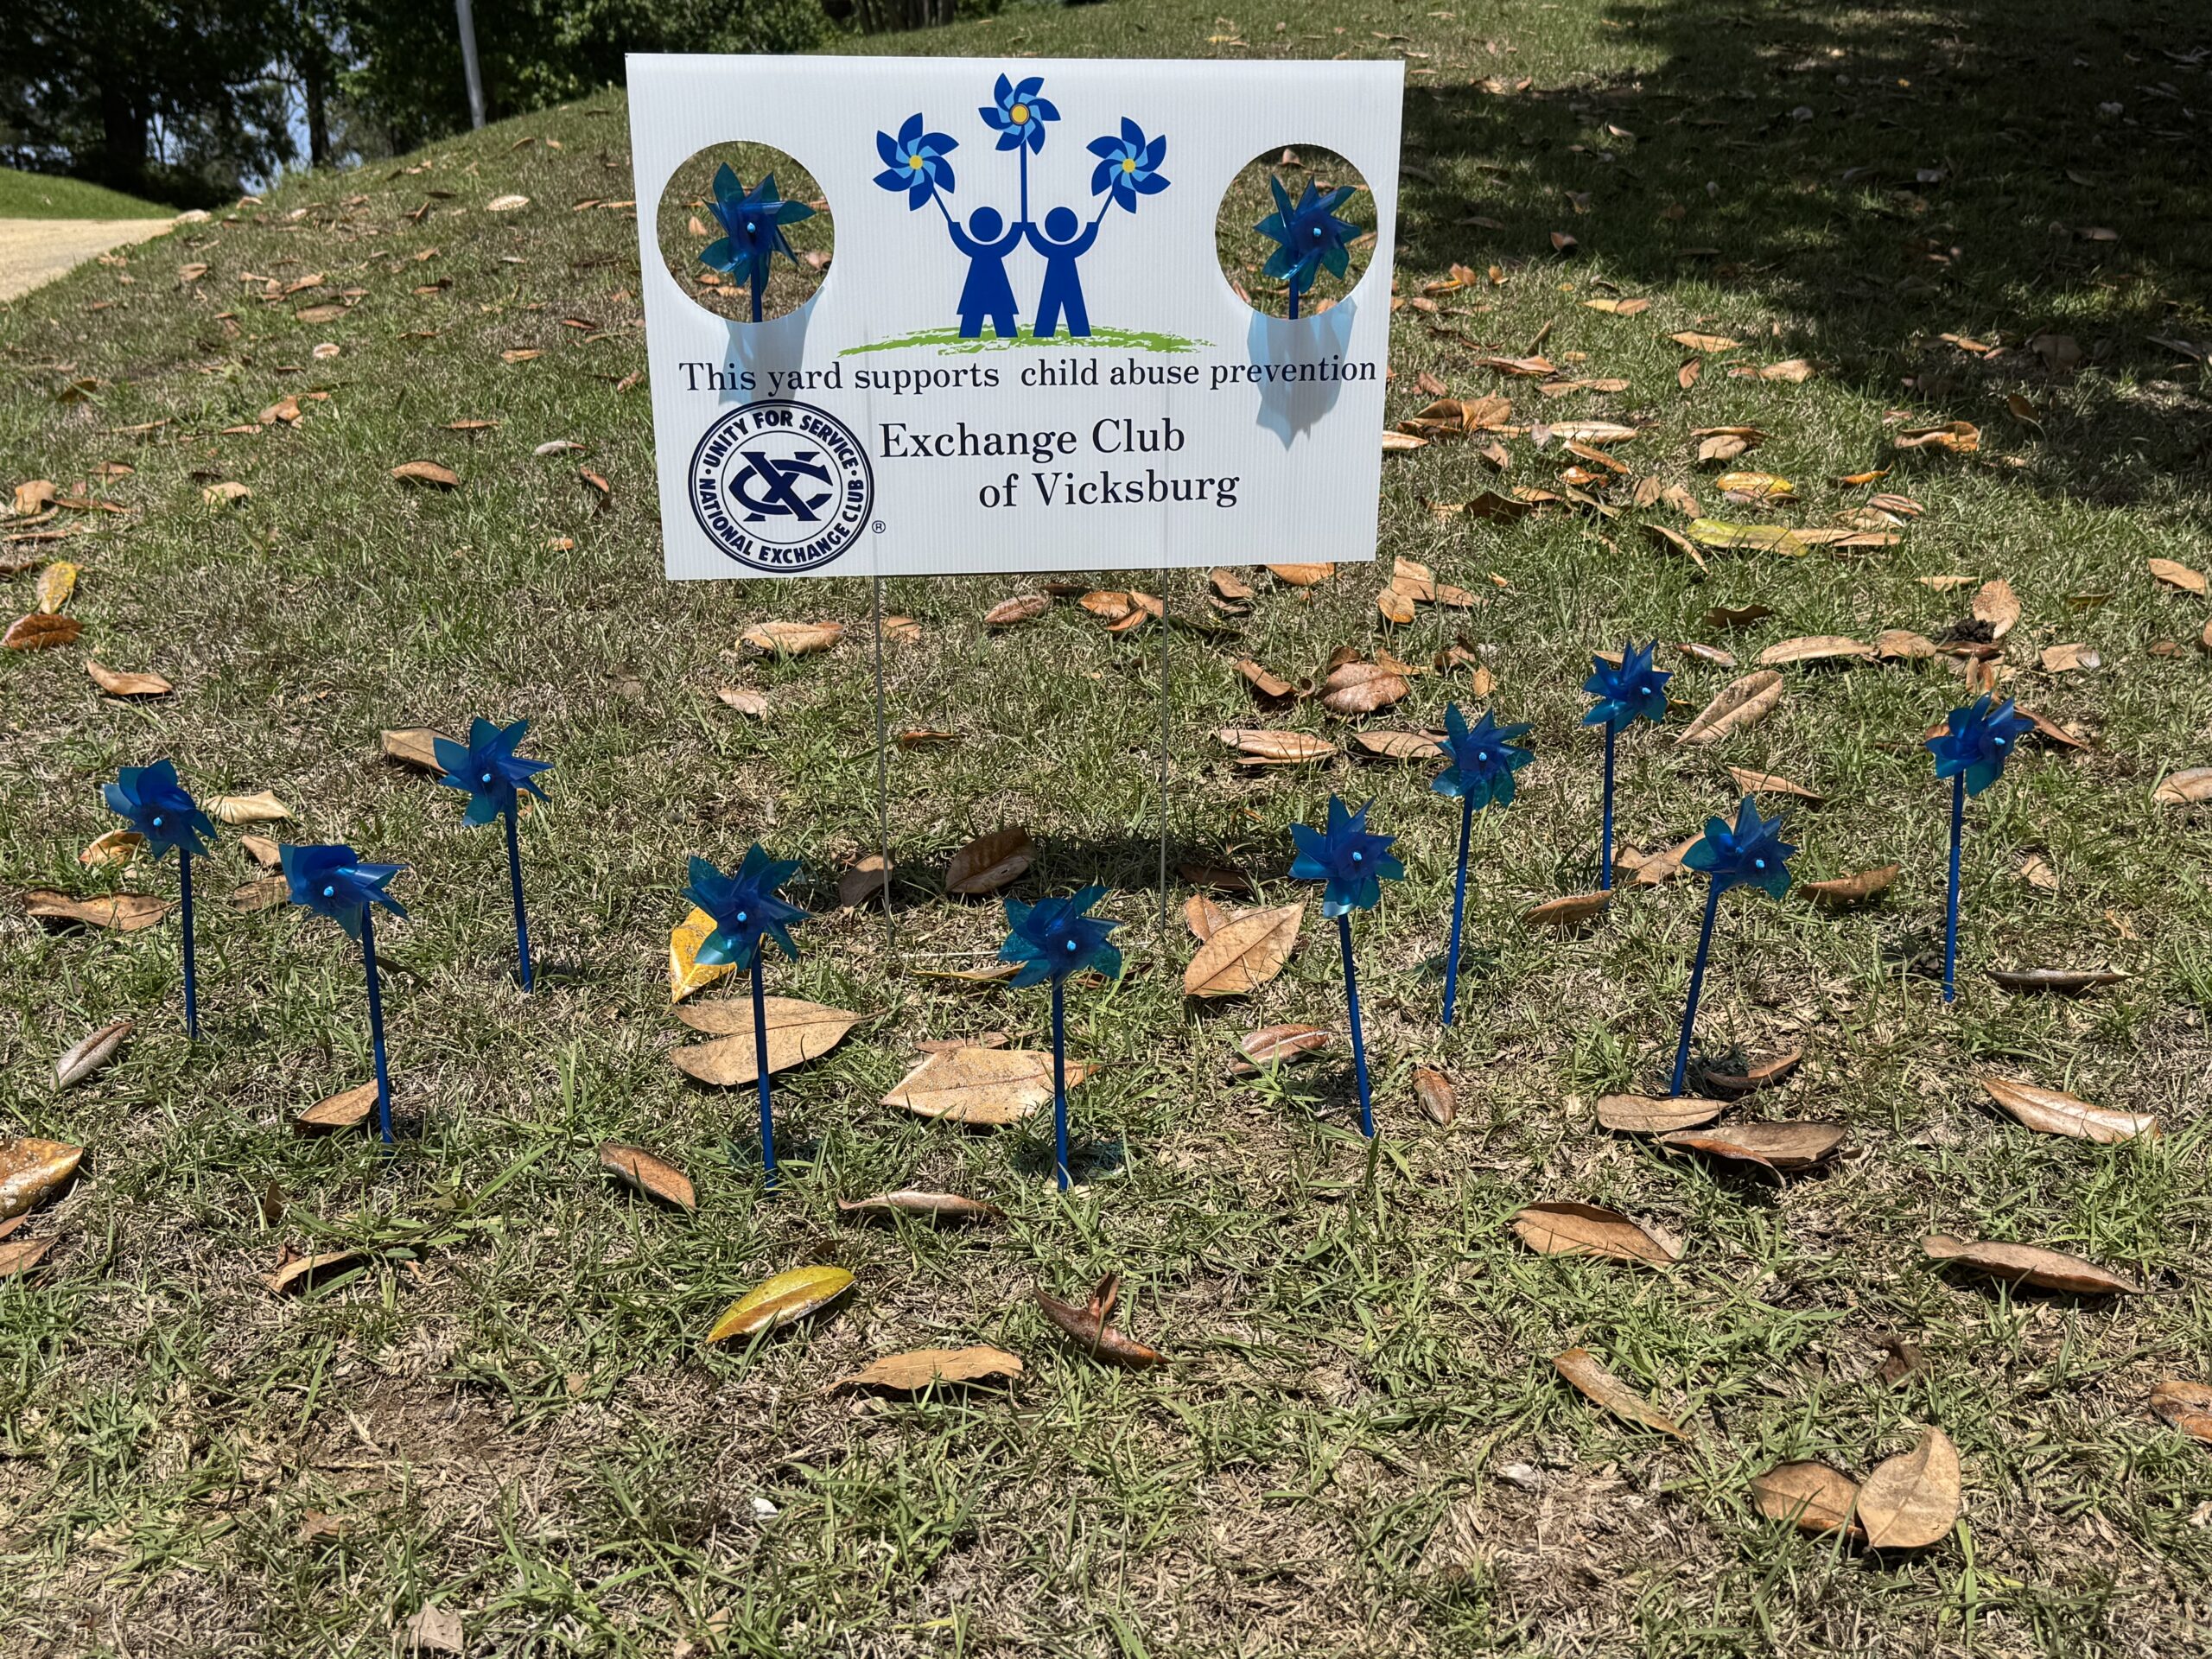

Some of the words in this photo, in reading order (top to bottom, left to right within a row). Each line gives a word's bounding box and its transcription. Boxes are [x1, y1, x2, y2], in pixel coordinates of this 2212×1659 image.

[679, 362, 756, 391] This
[767, 362, 842, 397] yard
[855, 363, 1000, 394] supports
[1020, 359, 1098, 386] child
[1109, 358, 1199, 385] abuse
[1210, 355, 1376, 390] prevention
[702, 418, 748, 467] UNITY
[753, 410, 793, 429] FOR
[799, 415, 859, 469] SERVICE
[879, 422, 1077, 464] Exchange
[1092, 417, 1185, 454] Club
[979, 474, 1019, 508] of
[1031, 469, 1240, 507] Vicksburg
[699, 478, 753, 556] NATIONAL
[758, 523, 850, 564] EXCHANGE
[842, 479, 864, 523] CLUB
